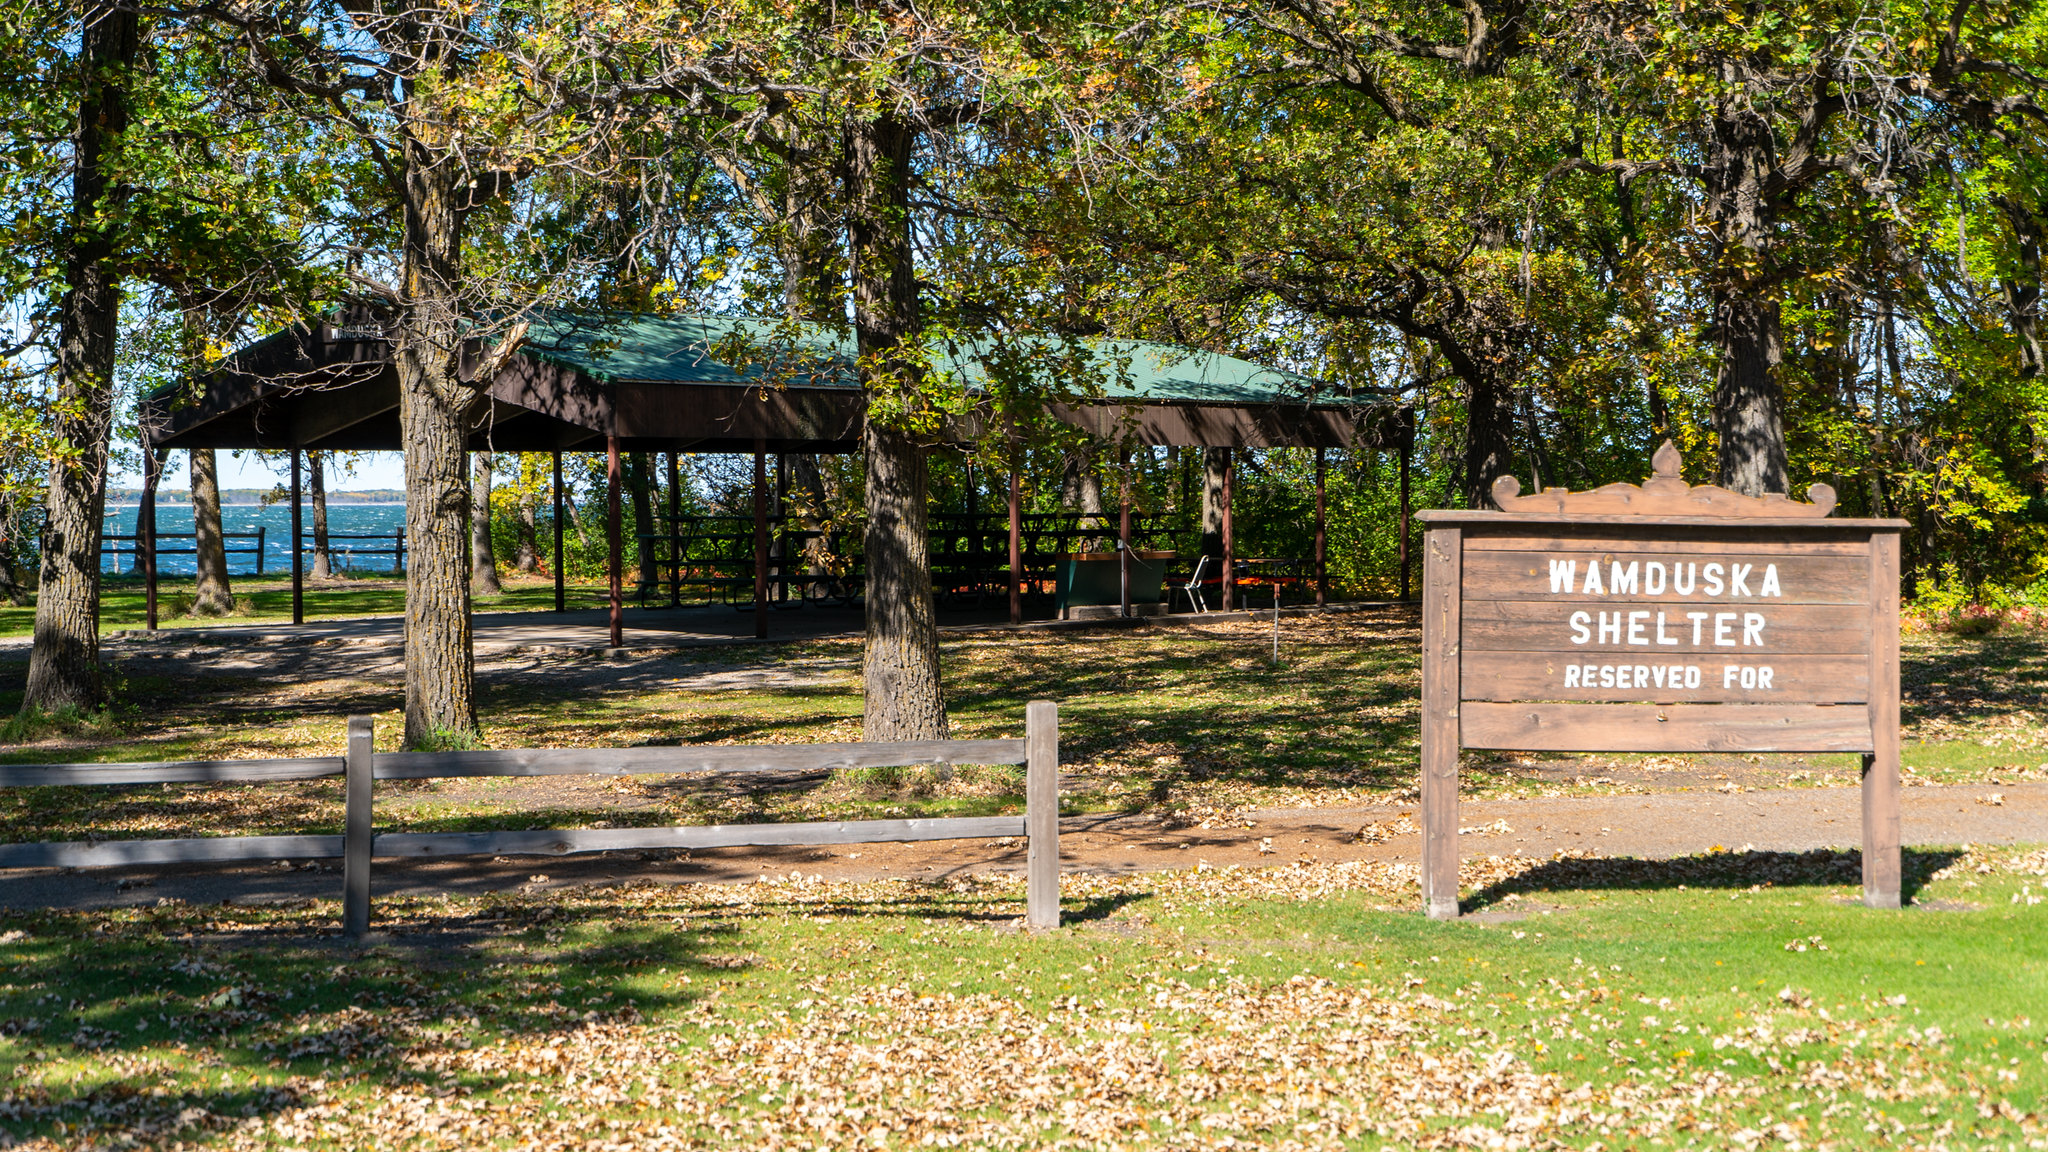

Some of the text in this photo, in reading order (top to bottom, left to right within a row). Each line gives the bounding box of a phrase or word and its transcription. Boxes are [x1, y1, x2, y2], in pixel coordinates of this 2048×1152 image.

[1549, 559, 1782, 598] WAMDUSKA
[1569, 610, 1766, 647] SHELTER
[1564, 664, 1774, 690] RESERVED FOR
